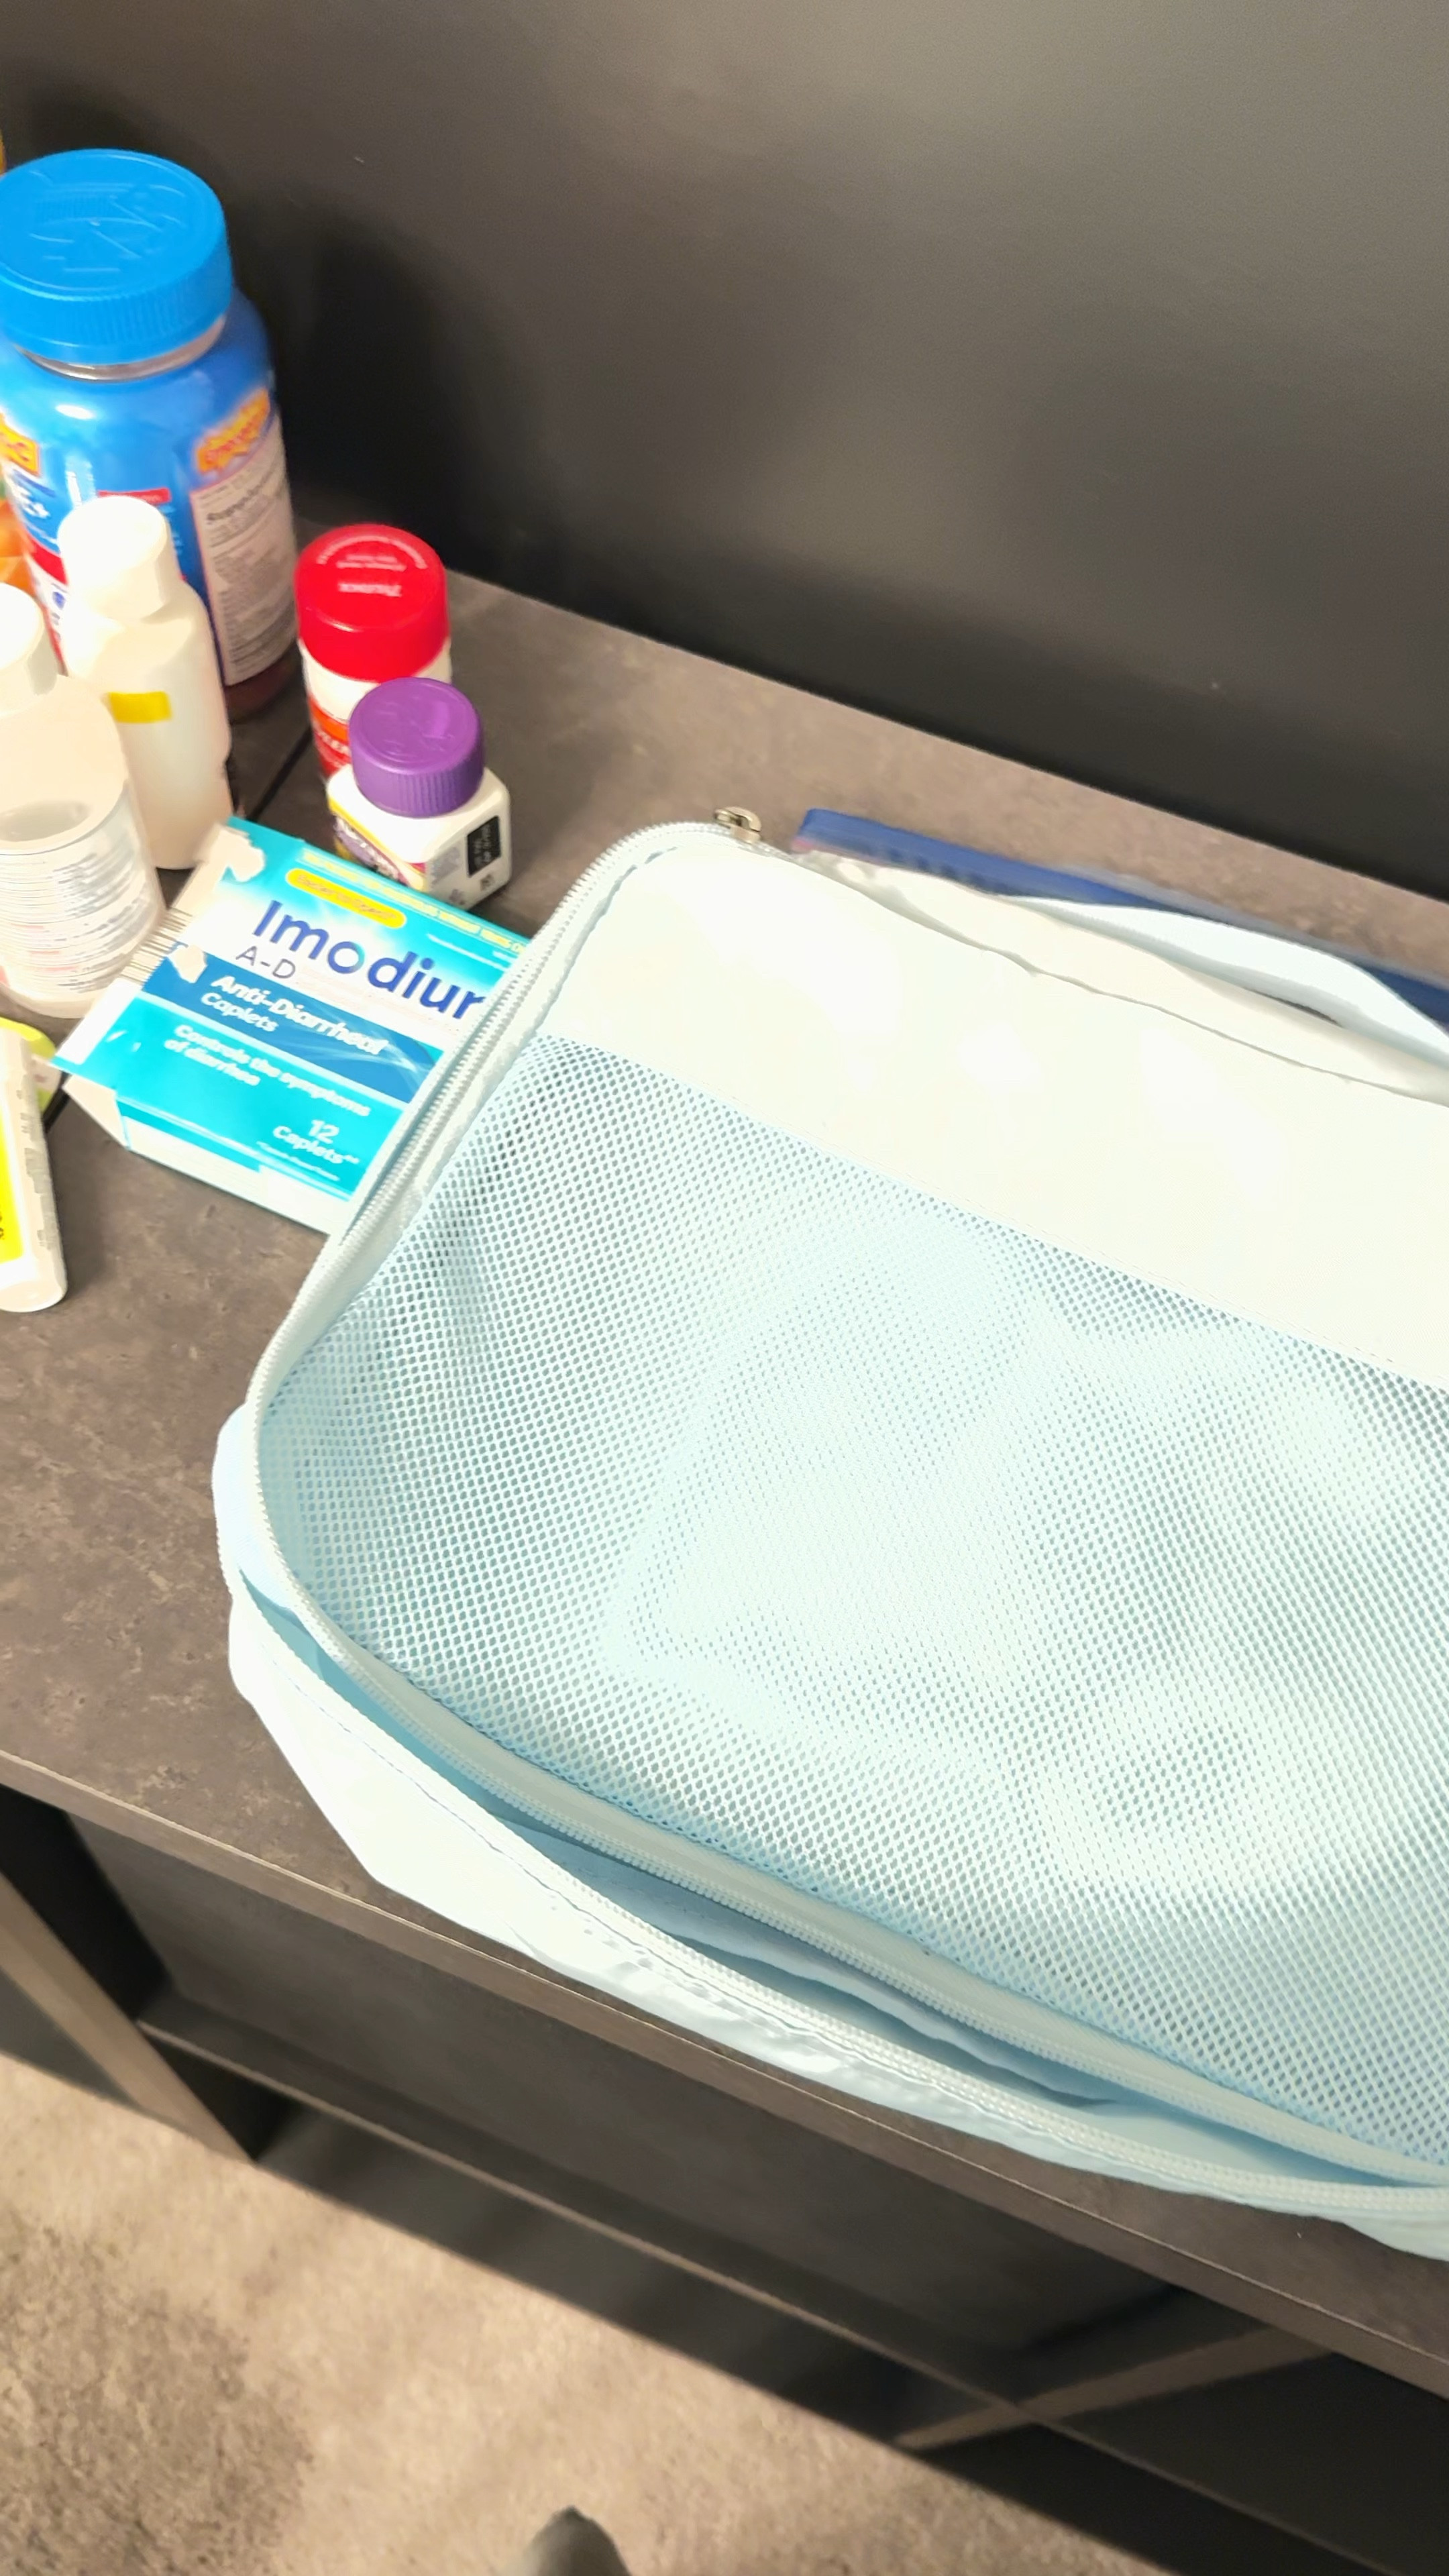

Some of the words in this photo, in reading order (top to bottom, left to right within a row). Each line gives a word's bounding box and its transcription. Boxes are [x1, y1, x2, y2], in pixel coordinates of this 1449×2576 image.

[236, 946, 296, 979] A-D
[201, 992, 278, 1032] Caplets
[211, 975, 388, 1055] Anti-Diarrheal
[164, 1039, 190, 1053] of
[184, 1047, 261, 1087] diarrhea
[174, 1024, 250, 1064] Controls
[249, 1057, 282, 1078] the
[279, 1073, 371, 1117] symptoms
[309, 1120, 339, 1144] 12
